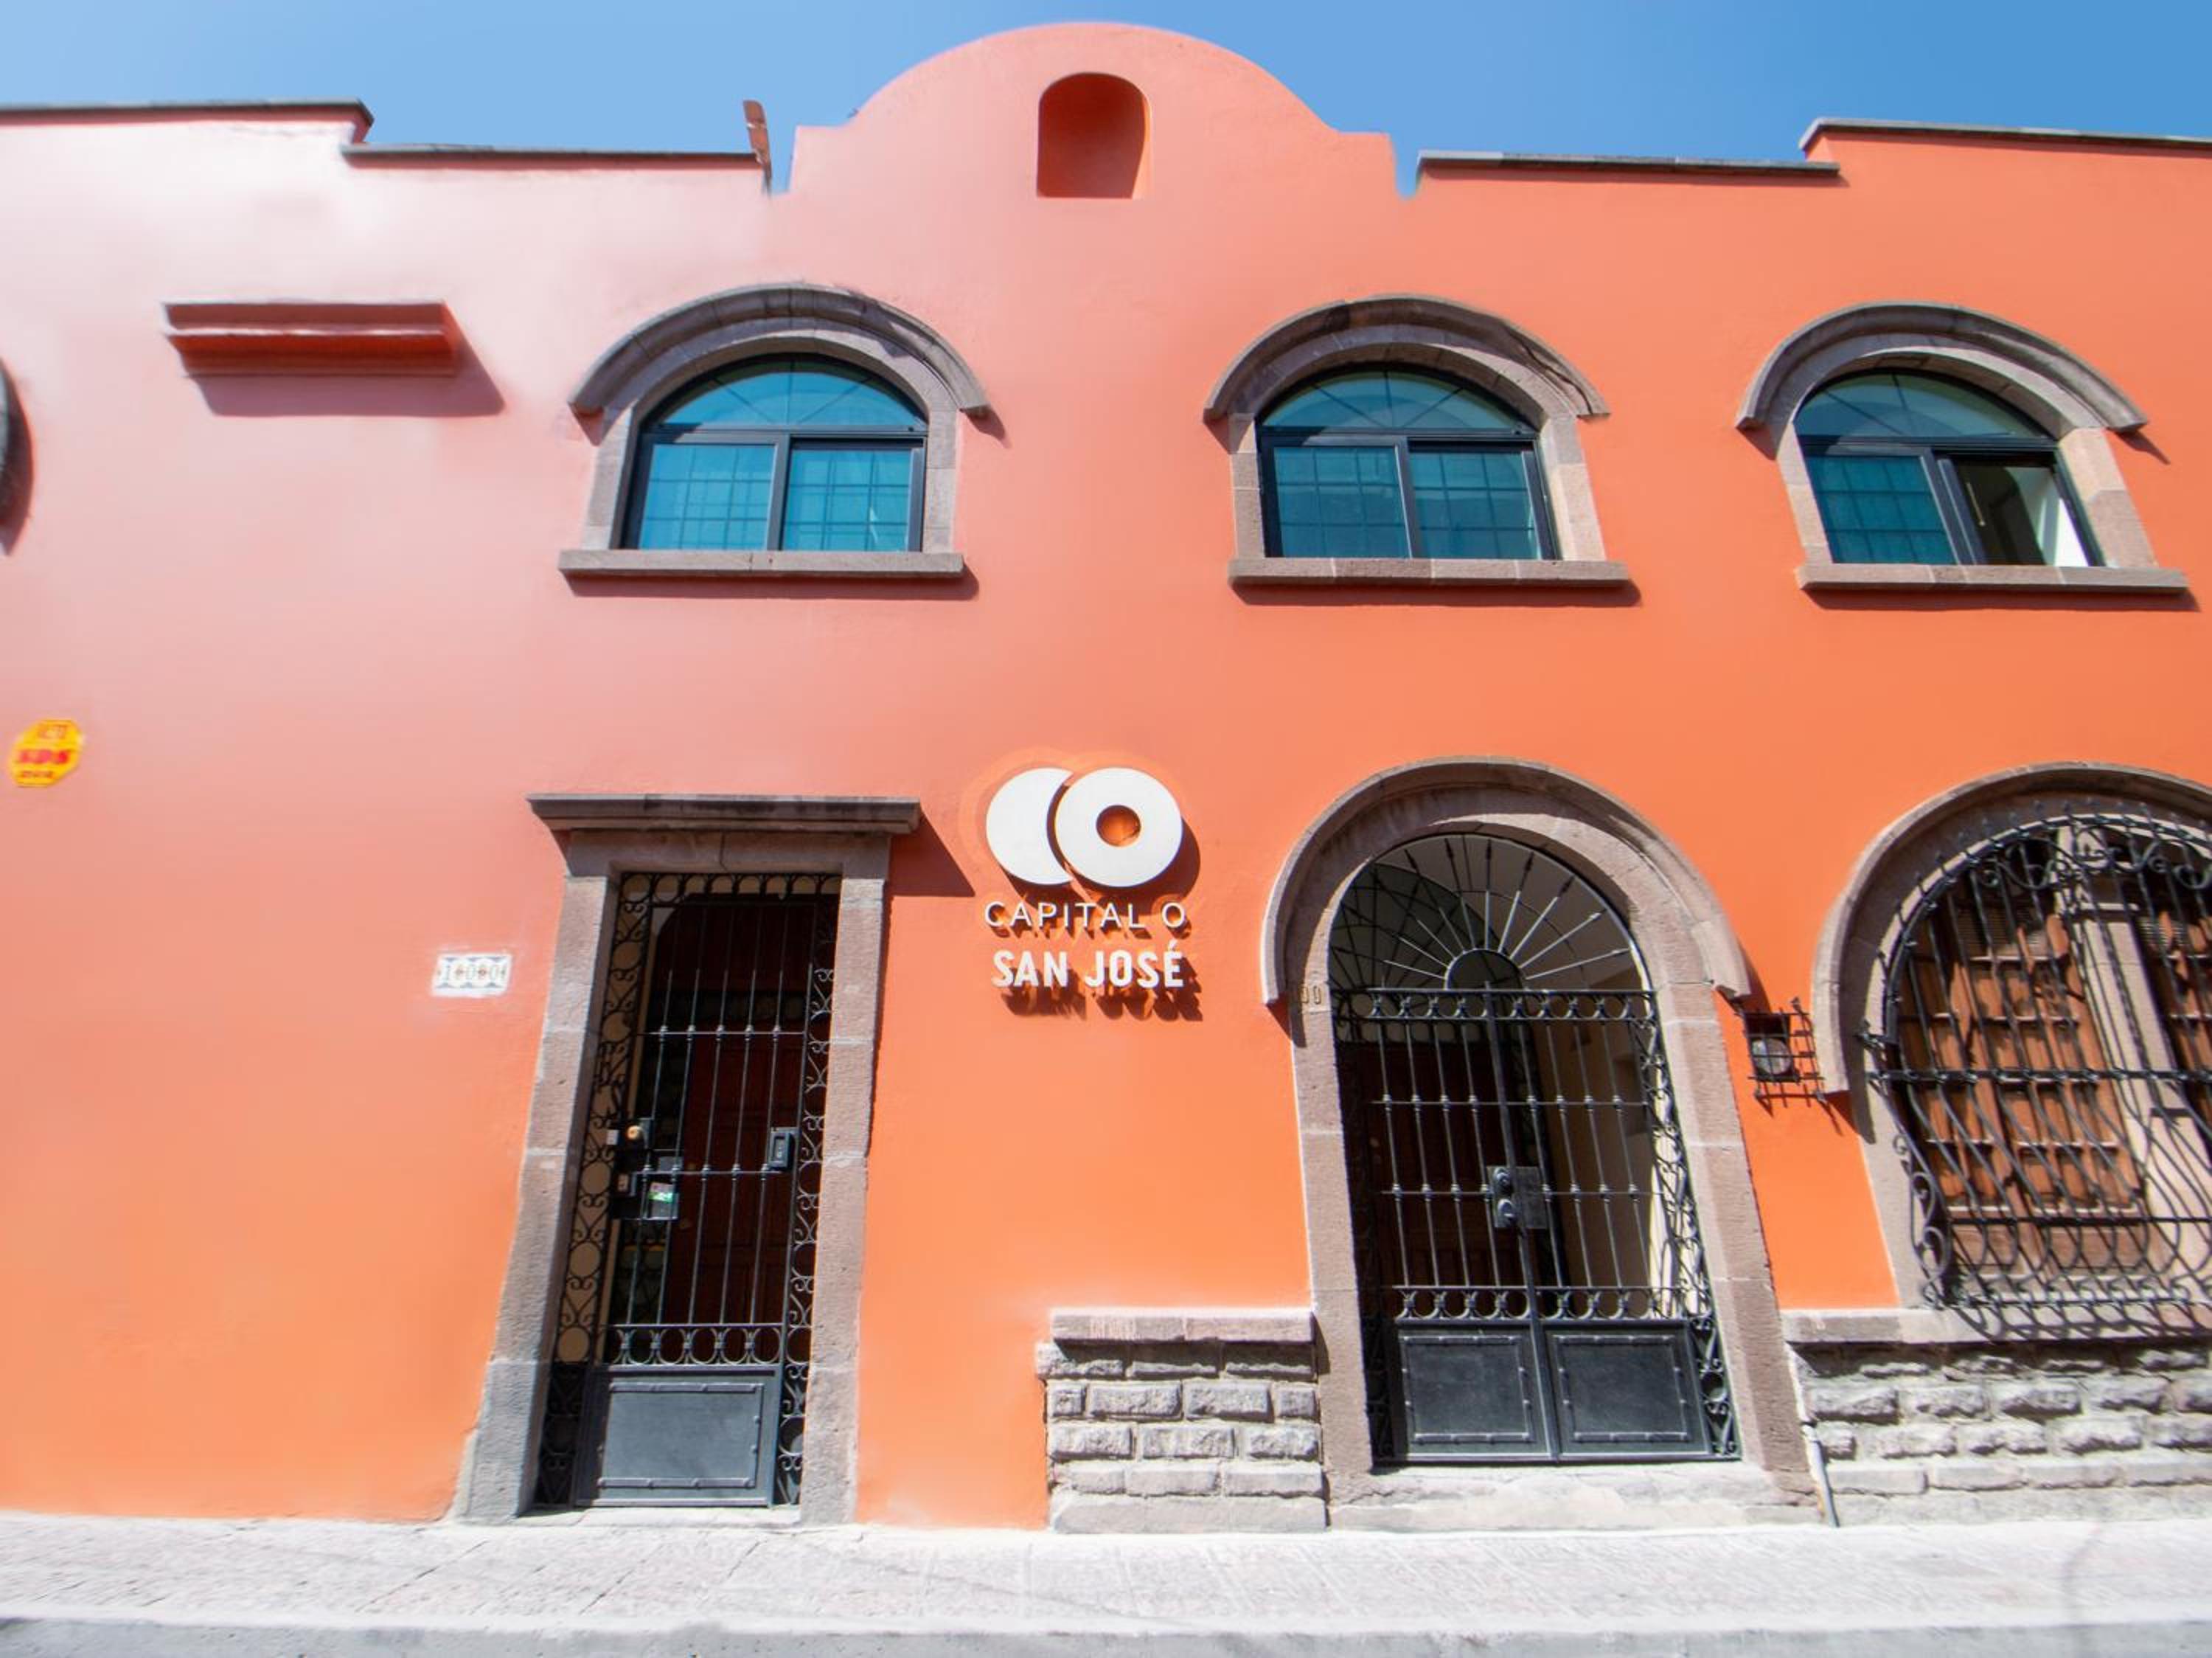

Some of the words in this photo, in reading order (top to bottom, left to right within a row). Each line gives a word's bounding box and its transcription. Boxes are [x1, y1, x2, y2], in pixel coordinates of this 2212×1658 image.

[984, 901, 1145, 928] CAPITAL
[1161, 902, 1186, 928] O
[992, 950, 1068, 988] SAN
[1085, 939, 1184, 988] JOSÉ
